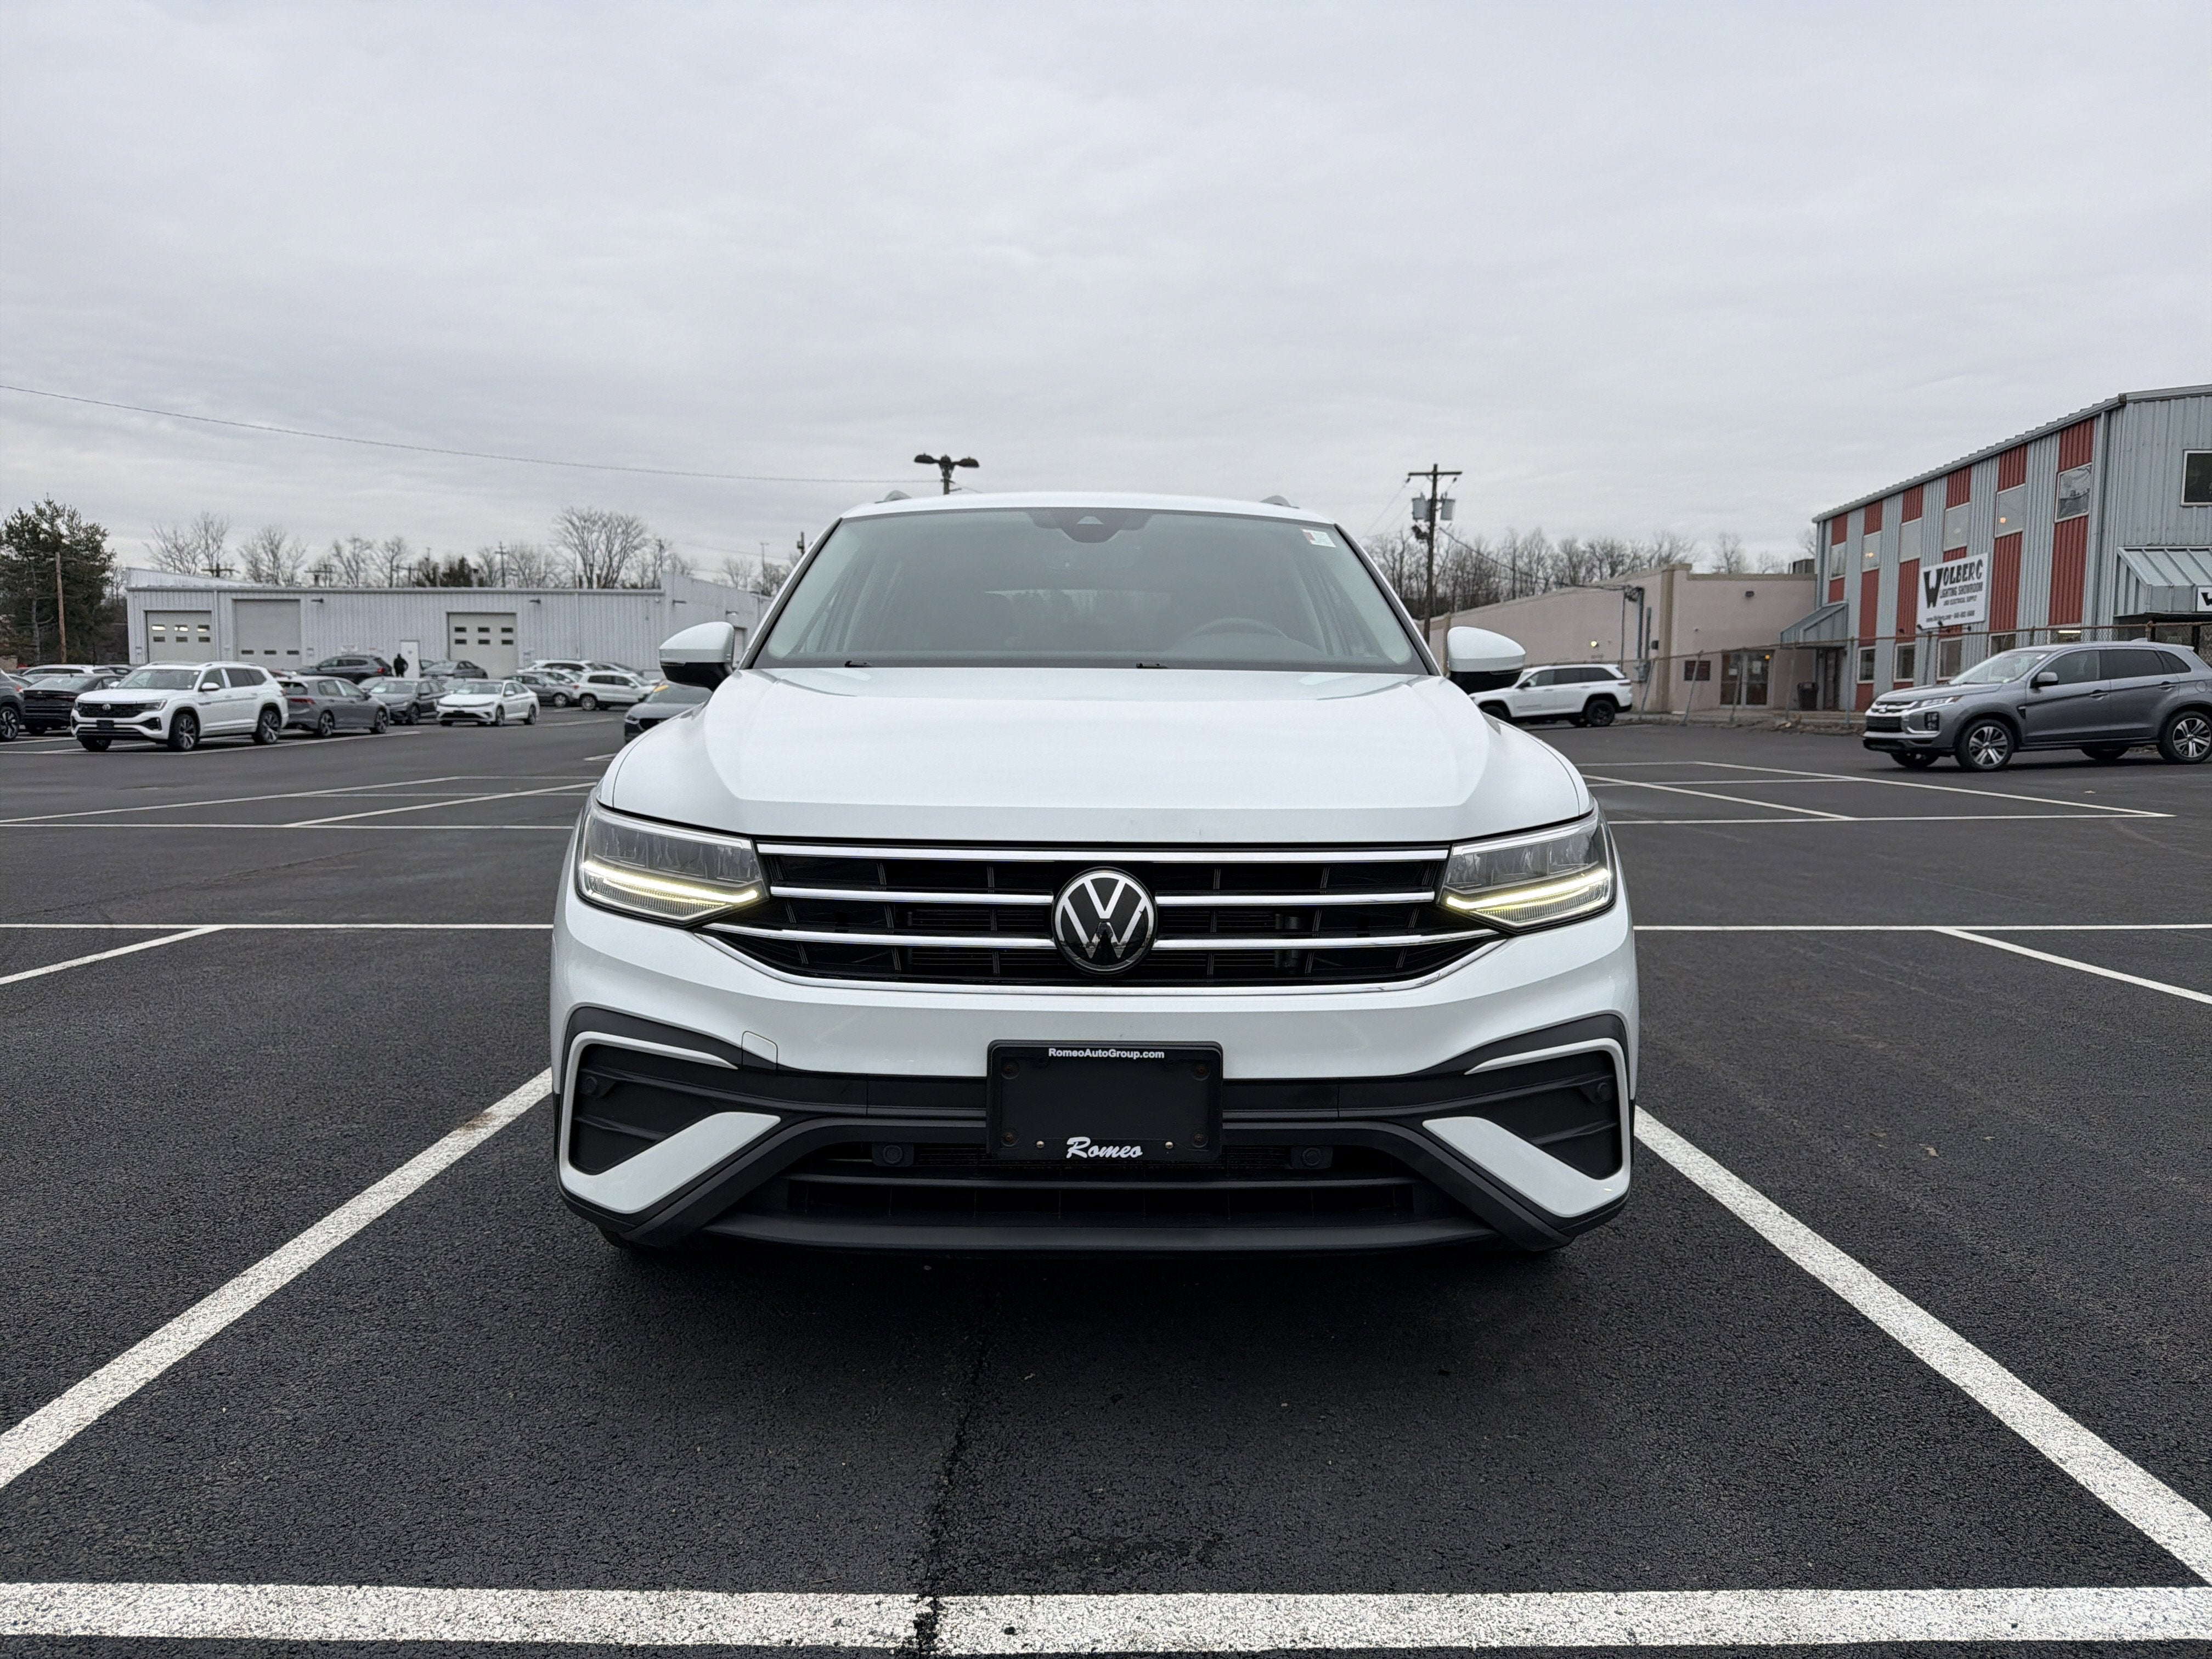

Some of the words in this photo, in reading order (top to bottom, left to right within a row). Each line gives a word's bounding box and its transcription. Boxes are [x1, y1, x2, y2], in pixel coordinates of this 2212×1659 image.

[1923, 559, 1984, 609] WOLBERG
[1048, 1048, 1165, 1059] RomeoAutoGroup.com
[1066, 1136, 1143, 1159] Romeo
